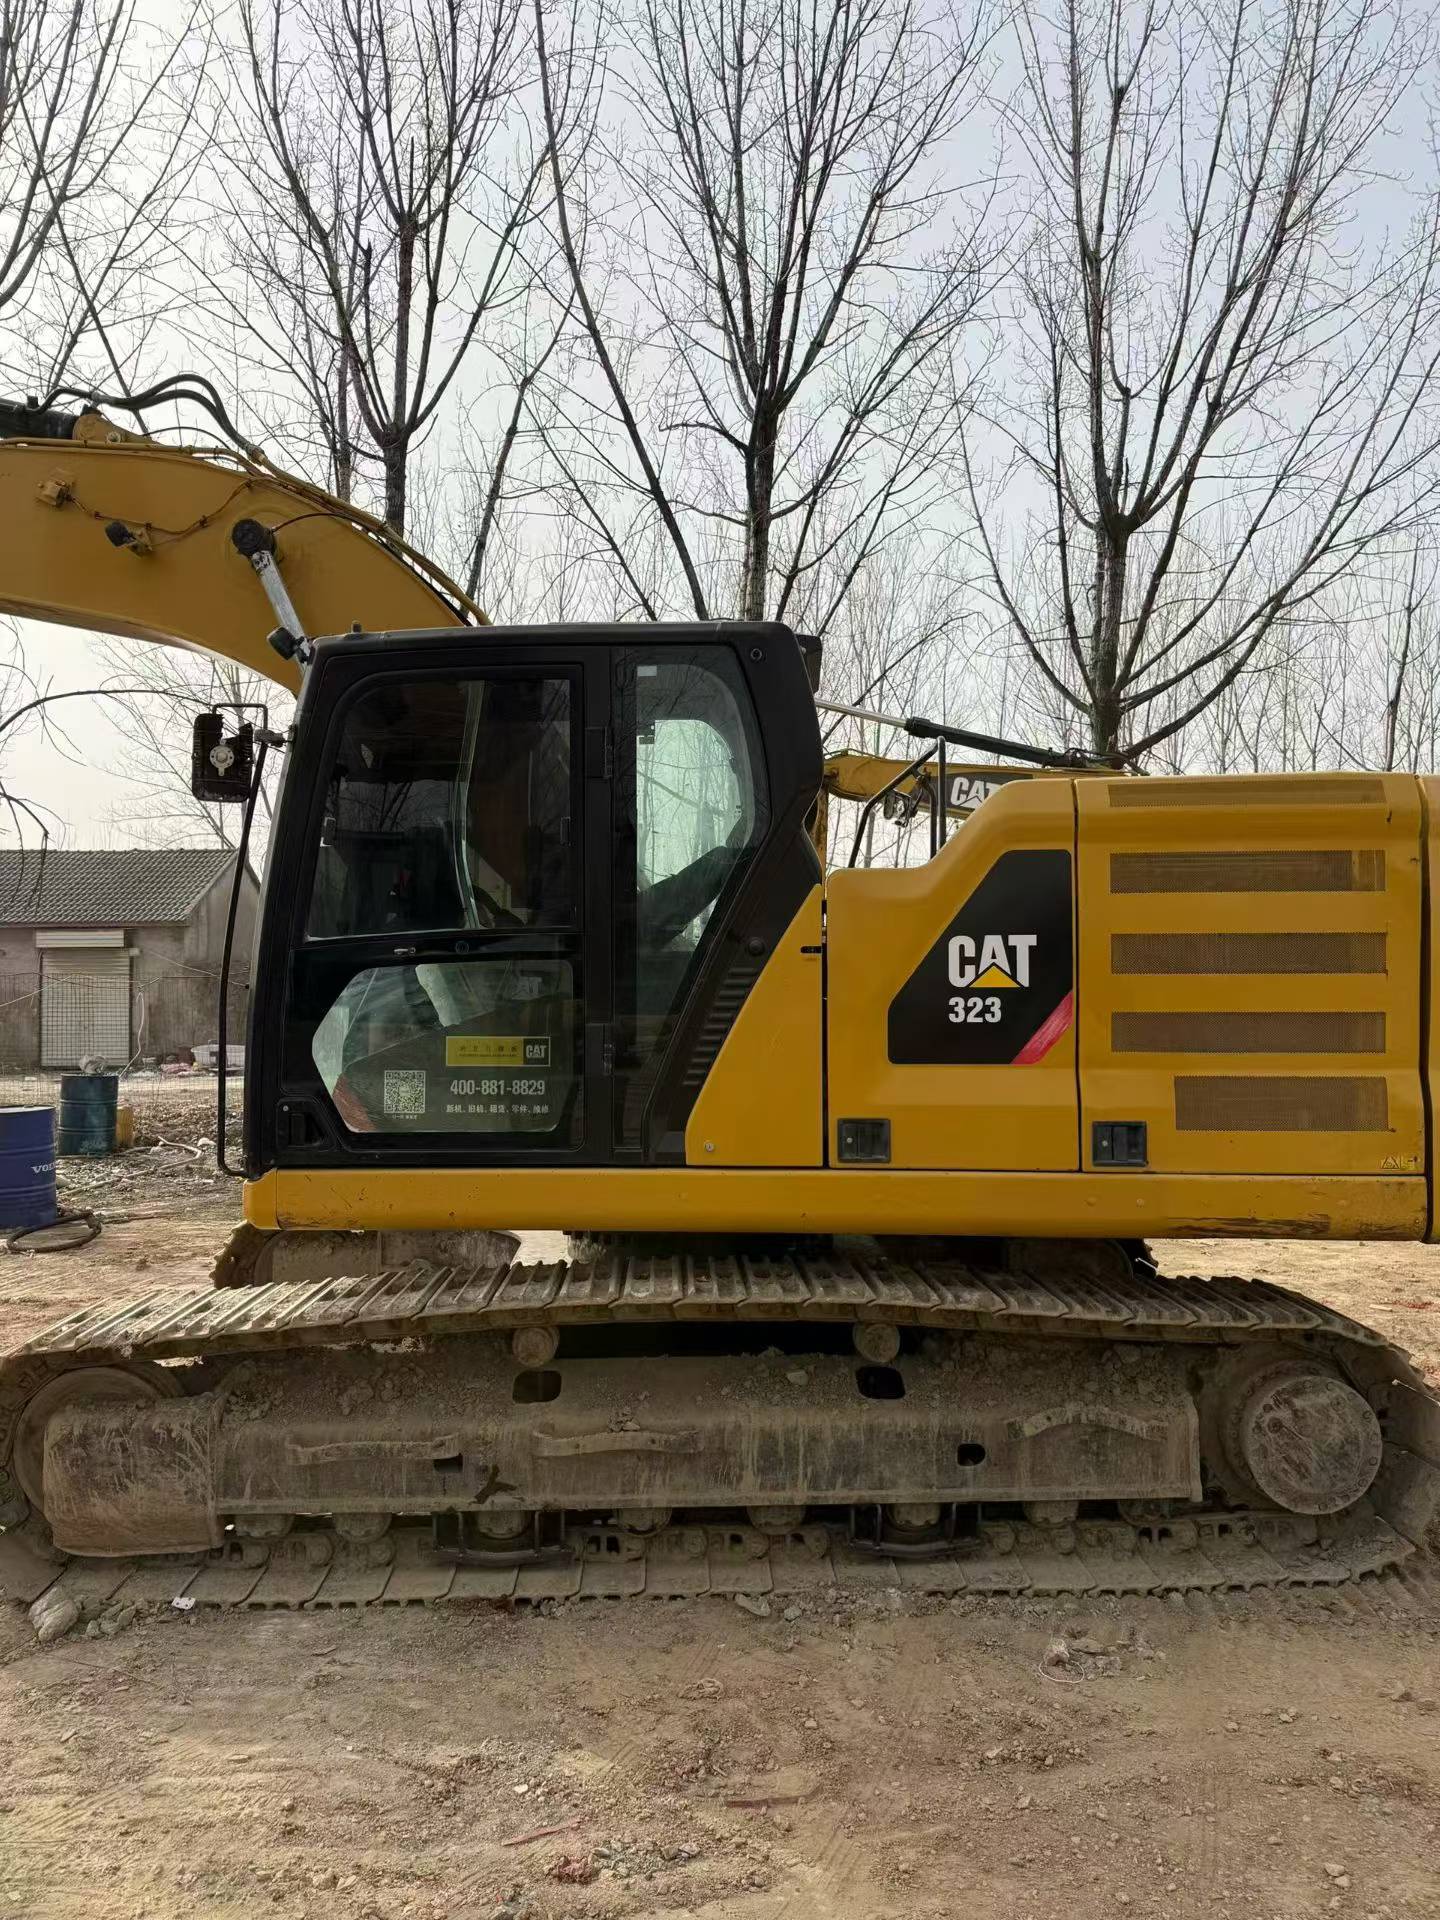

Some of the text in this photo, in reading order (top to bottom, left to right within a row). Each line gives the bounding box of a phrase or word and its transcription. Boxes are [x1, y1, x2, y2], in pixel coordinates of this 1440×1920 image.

[948, 934, 1037, 988] CAT
[948, 997, 1001, 1023] 323
[526, 1045, 547, 1059] CAT
[450, 1080, 545, 1095] 400-881-8829
